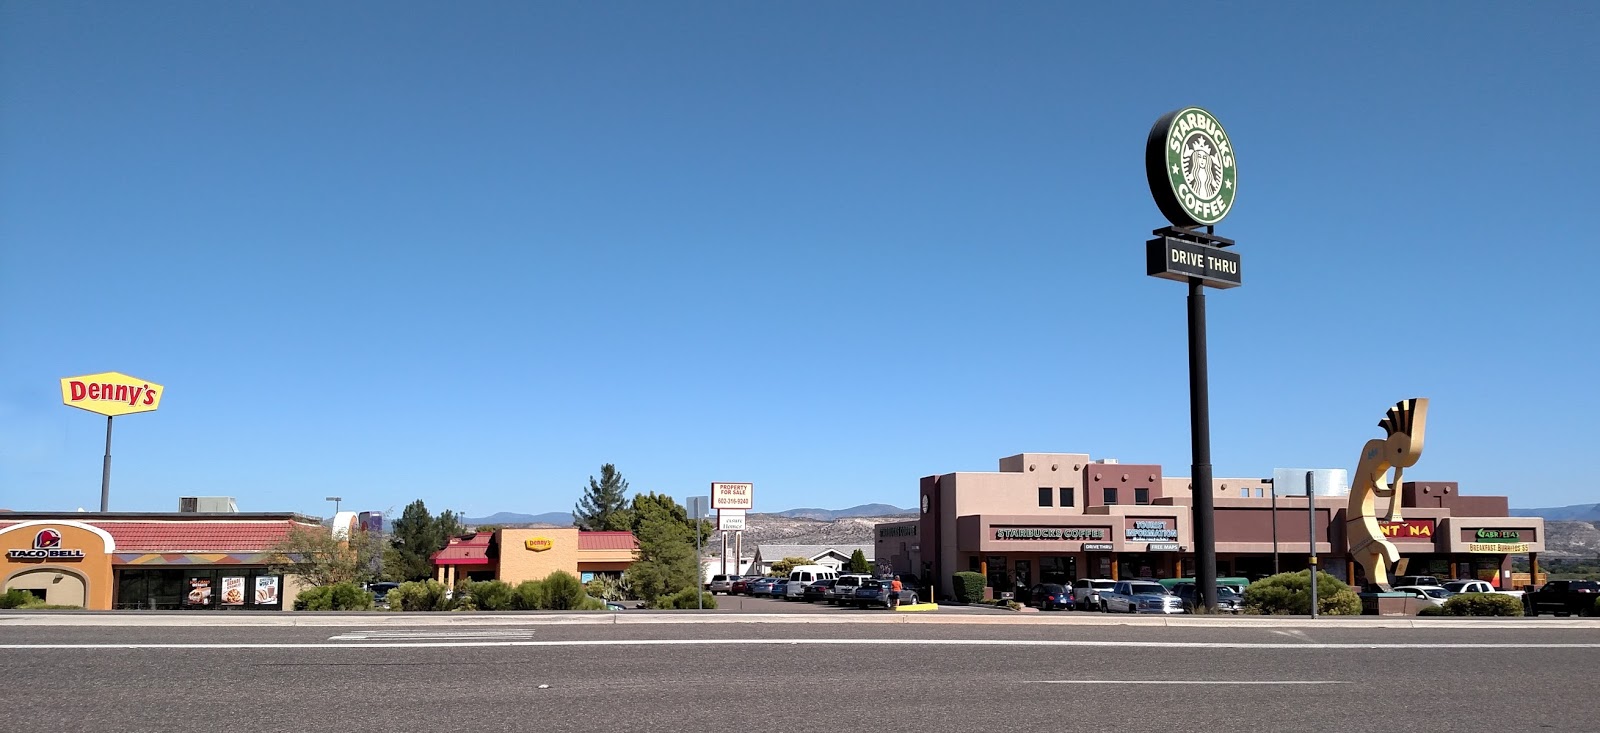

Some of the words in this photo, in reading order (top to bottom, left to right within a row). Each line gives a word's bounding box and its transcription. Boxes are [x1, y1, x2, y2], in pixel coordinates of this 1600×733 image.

[1170, 113, 1233, 169] STARBUCKS
[1178, 183, 1227, 219] COFFEE
[1171, 248, 1204, 268] DRIVE
[1207, 256, 1237, 275] THRU
[69, 381, 156, 406] Denny's
[997, 528, 1063, 538] STARBUCKS
[1064, 529, 1105, 538] COFFEE
[1126, 529, 1178, 537] INFORMATION
[9, 549, 48, 558] TACO
[48, 549, 85, 558] BELL
[1469, 543, 1497, 552] BREAKFAST
